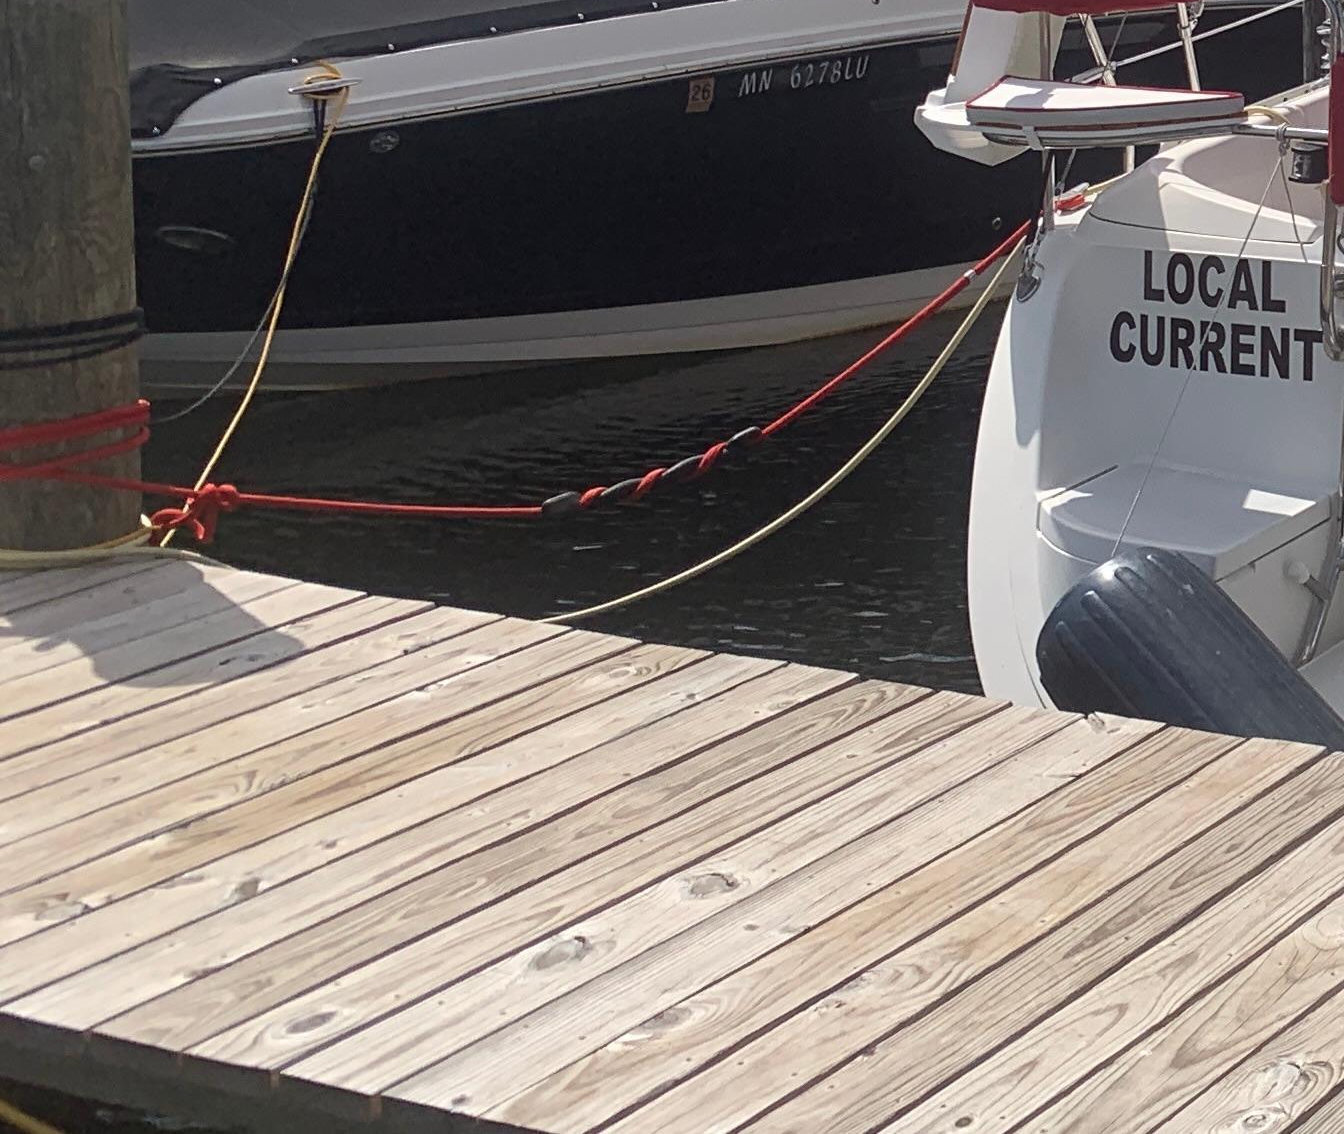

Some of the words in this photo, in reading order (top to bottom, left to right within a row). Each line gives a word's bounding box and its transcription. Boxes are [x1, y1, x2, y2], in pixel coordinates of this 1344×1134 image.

[691, 83, 711, 101] 26
[738, 69, 773, 97] MN
[790, 55, 870, 89] 6278LU
[1144, 250, 1286, 313] LOCAL
[1109, 311, 1323, 382] CURRENT
